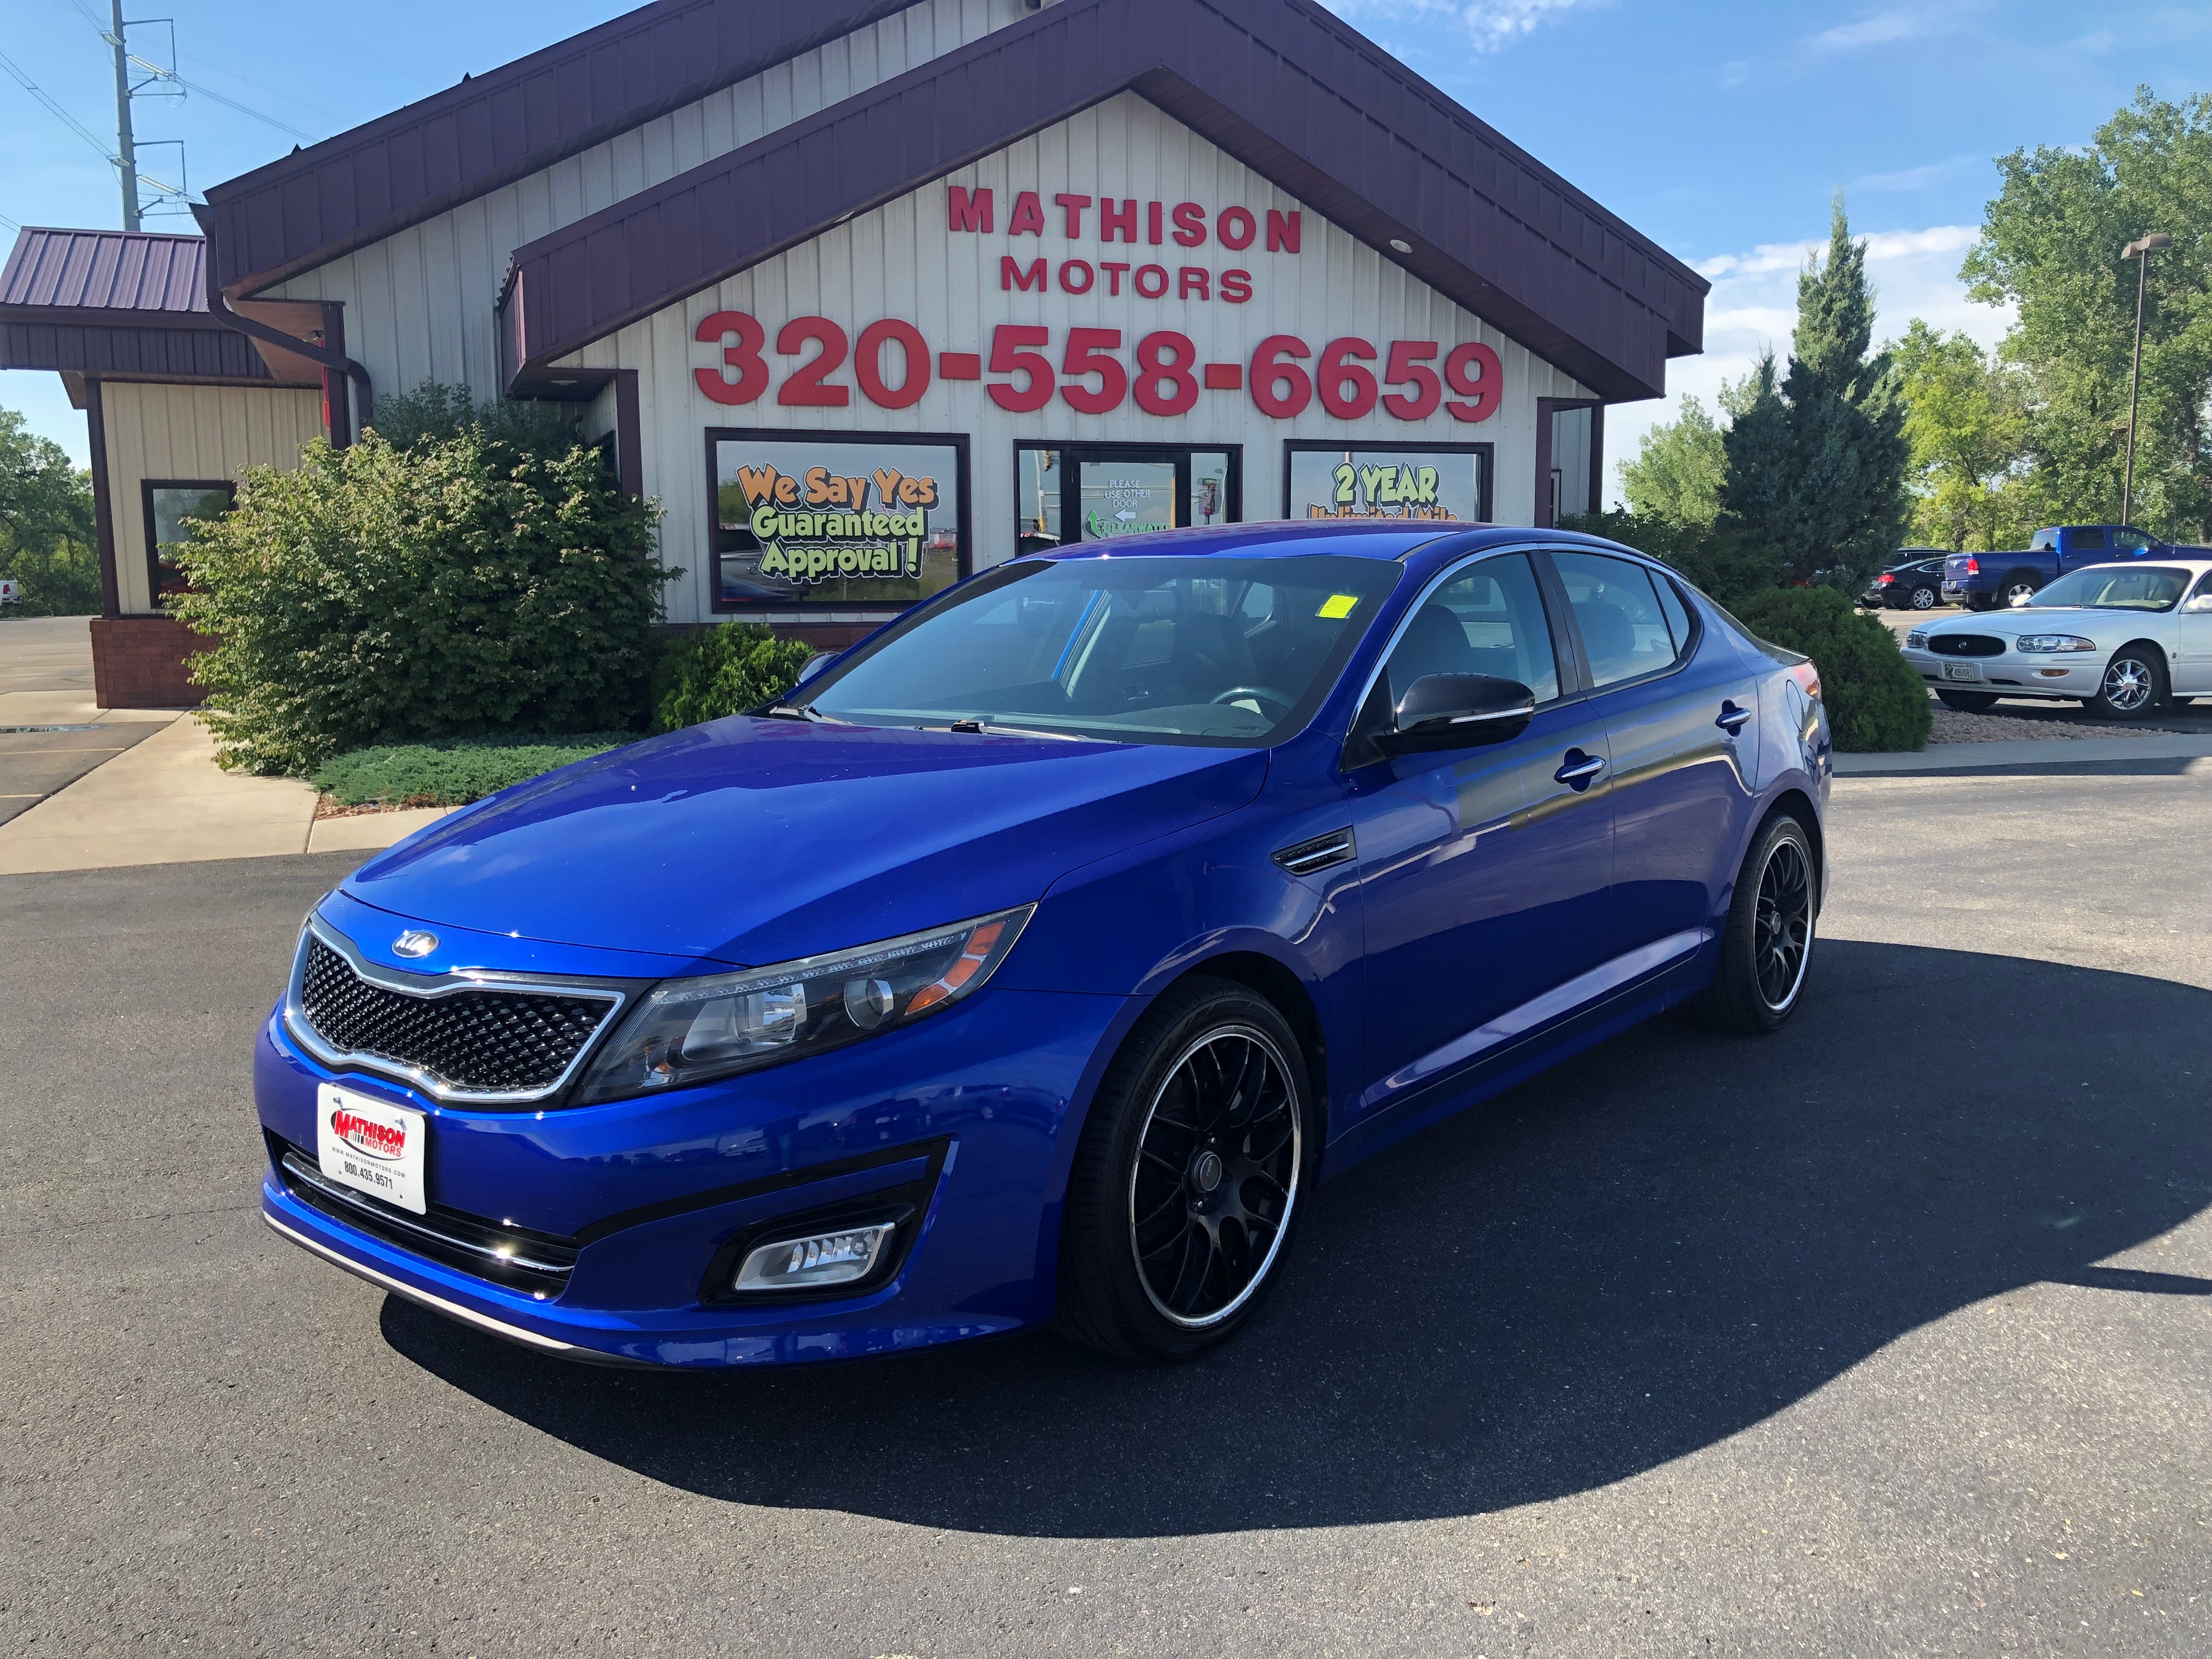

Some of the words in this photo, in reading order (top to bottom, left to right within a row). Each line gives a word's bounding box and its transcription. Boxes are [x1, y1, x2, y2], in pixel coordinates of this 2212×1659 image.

[948, 186, 1301, 253] MATHISON
[1001, 256, 1253, 303] MOTORS
[695, 311, 1503, 422] 320-558-6659
[736, 463, 799, 506] We
[804, 466, 867, 510] Say
[873, 466, 936, 504] Yes
[1104, 490, 1121, 499] USE
[1124, 489, 1150, 498] OTHER
[1109, 479, 1141, 489] PLEASE
[1335, 465, 1356, 503] 2
[1359, 464, 1436, 503] YEAR
[1113, 499, 1138, 508] DOOR
[752, 506, 925, 538] Guaranteed
[334, 1109, 406, 1148] MATHISON
[332, 1146, 405, 1178] WWW.MATHISONMOTORS.COM
[365, 1138, 402, 1158] MOTORS
[345, 1161, 393, 1190] 800.435.9571
